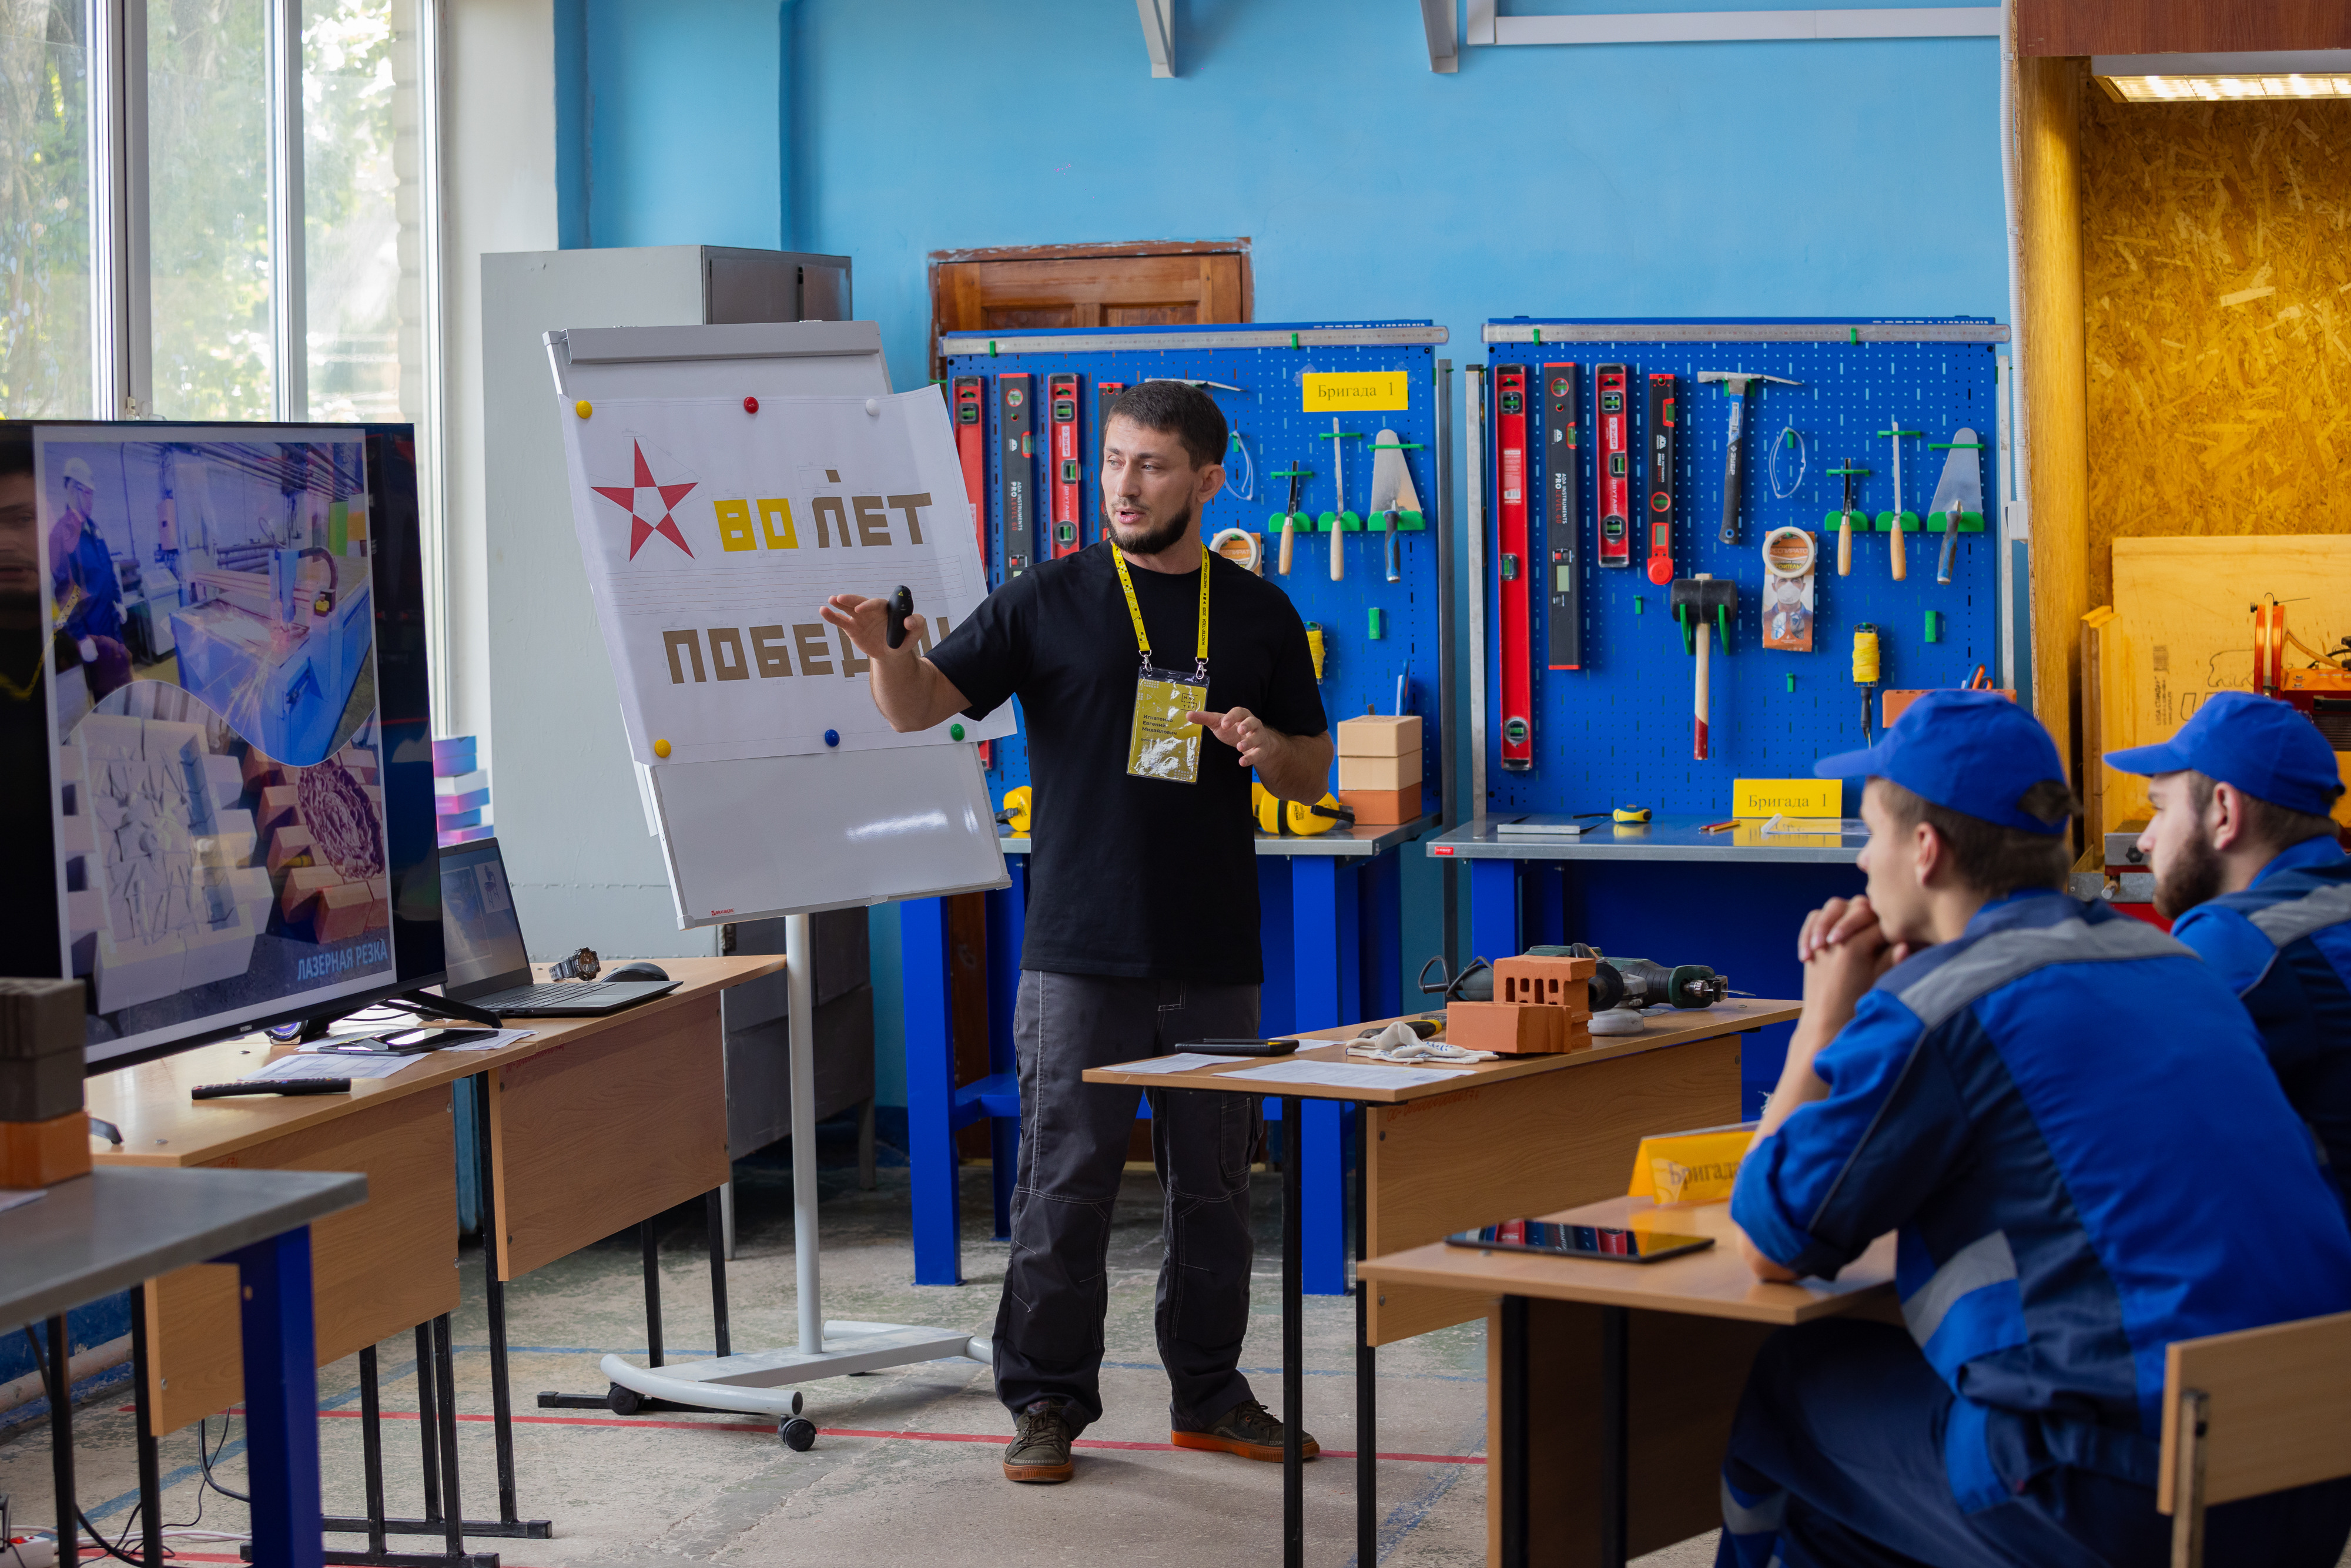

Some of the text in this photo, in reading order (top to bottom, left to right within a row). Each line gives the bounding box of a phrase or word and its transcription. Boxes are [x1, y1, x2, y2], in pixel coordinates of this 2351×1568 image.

[1318, 382, 1394, 401] Бригада 1
[714, 492, 933, 552] 80 ЛЕТ
[1556, 514, 1562, 524] 60
[1012, 522, 1017, 531] 60
[1143, 714, 1173, 723] Игнатенко
[1141, 726, 1177, 736] Михайлович
[1749, 793, 1827, 810] Бригада 1
[297, 939, 388, 981] ЛАЗЕРНАЯ РЕЗКА
